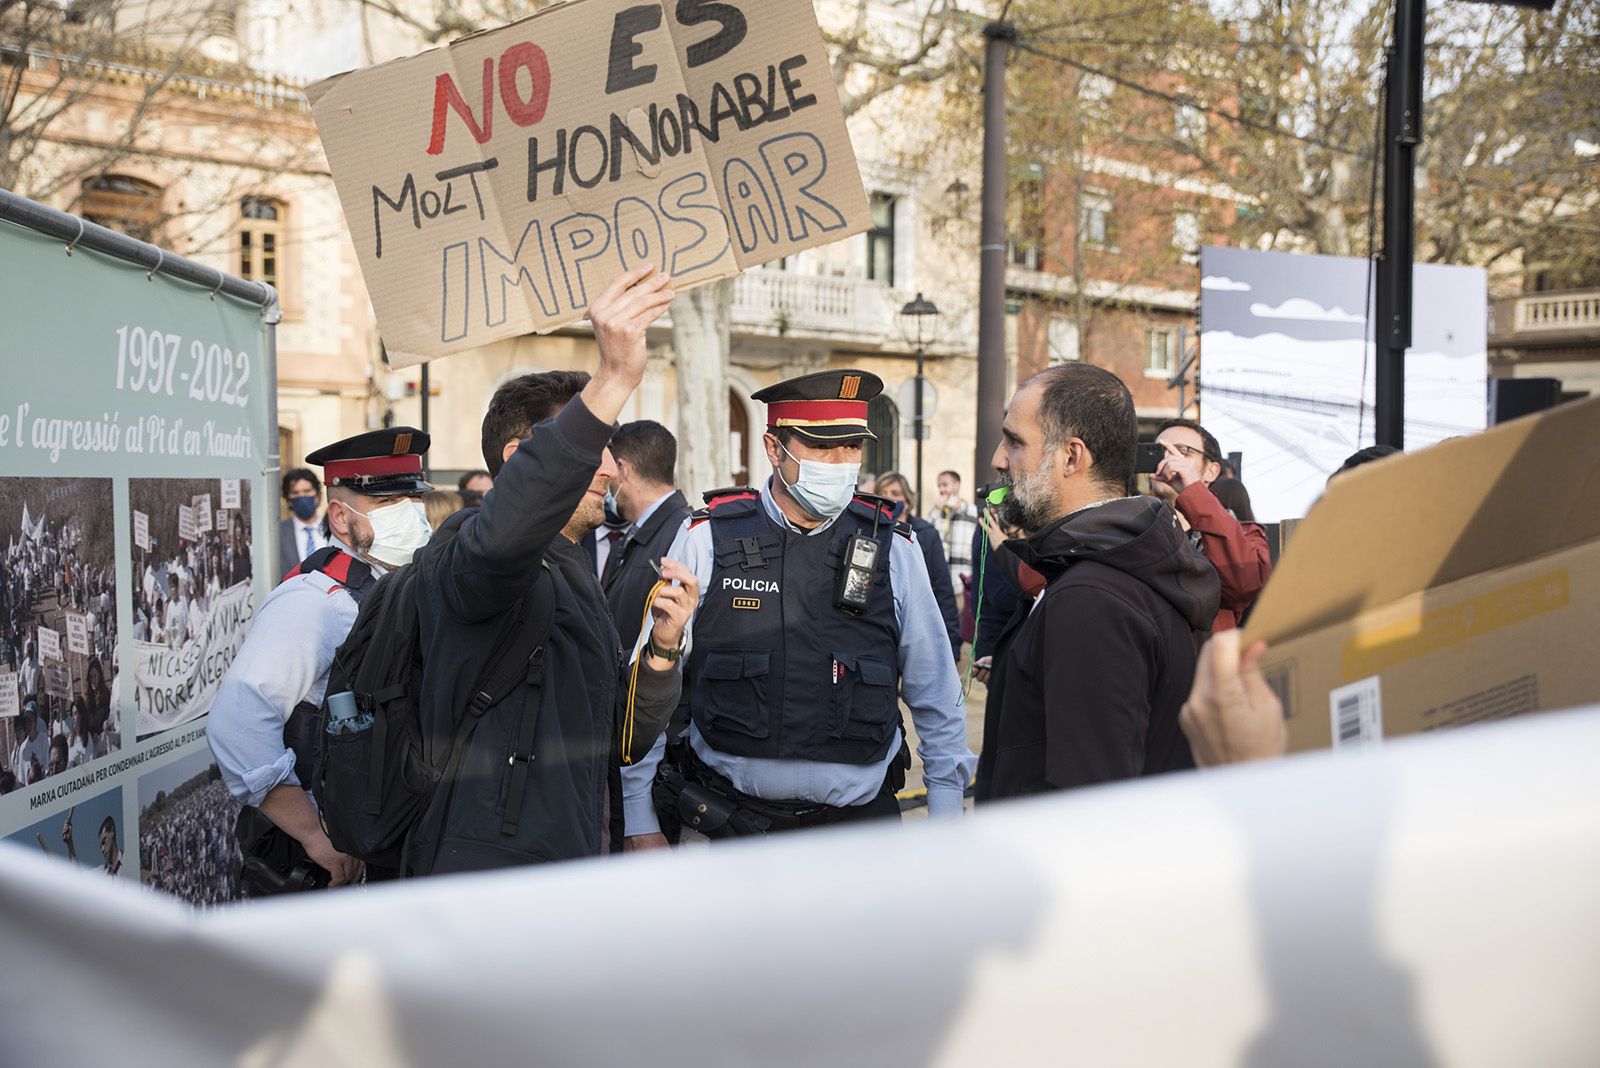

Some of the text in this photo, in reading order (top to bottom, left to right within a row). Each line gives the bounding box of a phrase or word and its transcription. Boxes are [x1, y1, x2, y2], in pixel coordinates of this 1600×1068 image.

[426, 0, 747, 154] NO ES
[372, 54, 817, 258] MOLT HONORABLE
[442, 131, 847, 343] IMPOSAR
[116, 325, 250, 407] 1997-2022
[125, 416, 144, 453] al
[147, 414, 165, 454] Pi
[722, 577, 780, 593] POLICIA
[146, 676, 194, 714] TORRE
[148, 652, 164, 677] NI
[29, 788, 57, 810] MARXA
[57, 772, 96, 798] CIUTADANA
[96, 766, 108, 783] PER
[108, 751, 145, 777] CONDEMNAR
[145, 738, 174, 761] L'AGRESSIÓ
[174, 737, 182, 748] AL
